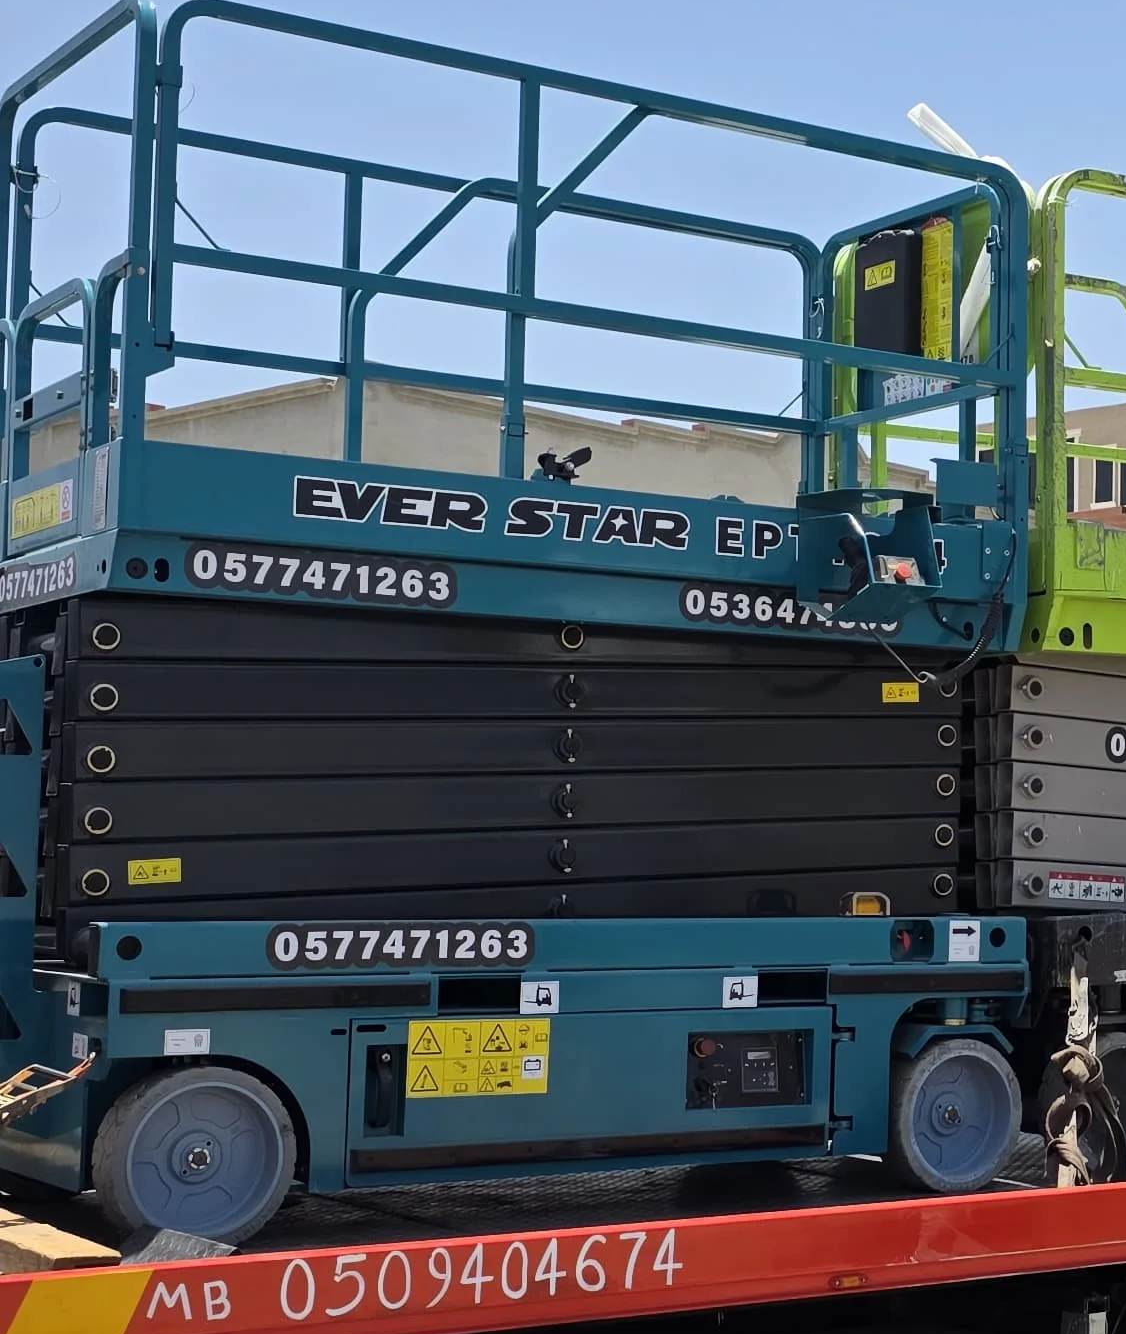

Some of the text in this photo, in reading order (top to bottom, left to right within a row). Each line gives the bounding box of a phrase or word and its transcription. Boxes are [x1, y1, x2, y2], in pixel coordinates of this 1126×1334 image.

[294, 475, 488, 533] EVER
[504, 496, 691, 551] STAR
[193, 549, 451, 601] 0577471263
[273, 929, 529, 962] 0577471263
[280, 1227, 683, 1323] 0509404674
